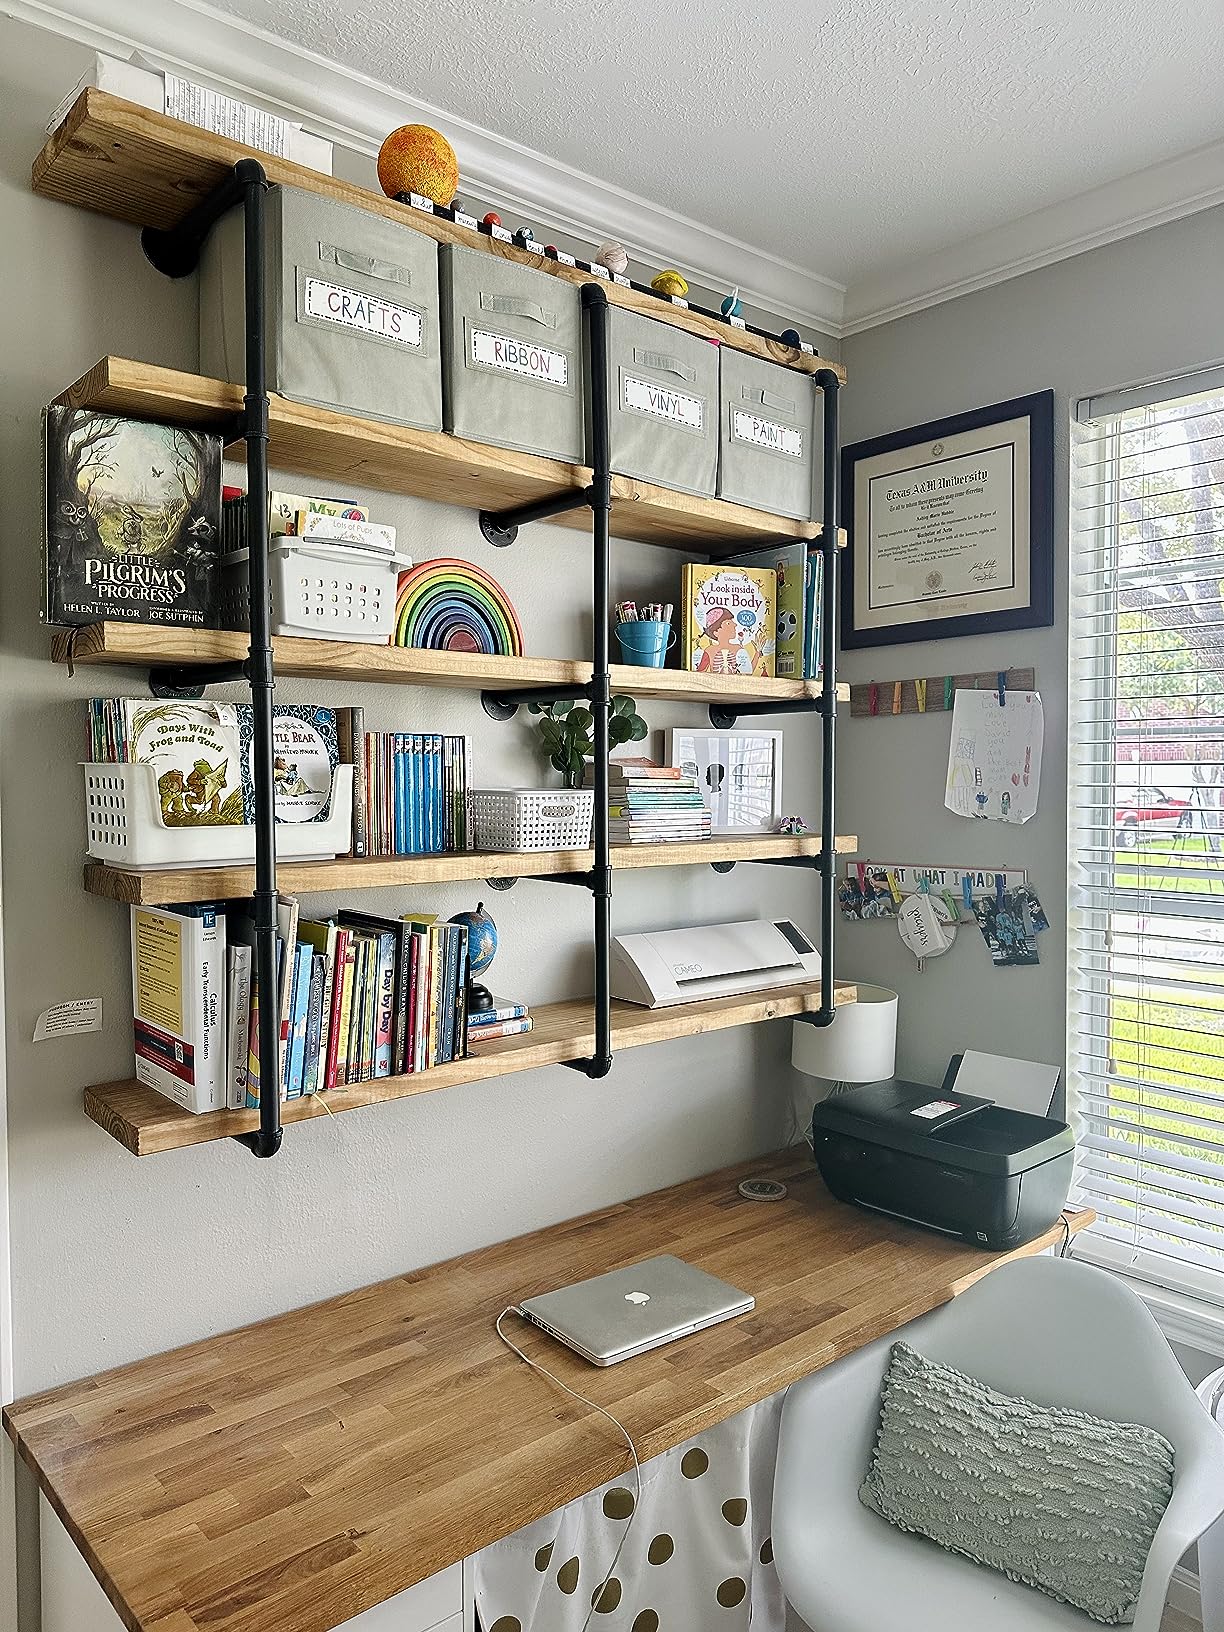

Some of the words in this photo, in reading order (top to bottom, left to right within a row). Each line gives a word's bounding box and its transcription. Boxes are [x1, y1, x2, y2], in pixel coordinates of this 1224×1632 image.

[327, 292, 402, 333] CRAFTS
[494, 341, 551, 374] RIBBON
[648, 390, 685, 417] VINYL
[752, 421, 786, 446] PAINT
[886, 488, 914, 501] Texas
[911, 480, 936, 495] A&M
[938, 469, 988, 489] University
[309, 501, 337, 517] My
[347, 524, 356, 532] of
[356, 524, 373, 535] Pups
[942, 525, 952, 533] Arts
[118, 554, 154, 567] LITTLE
[84, 558, 186, 595] PILGRIM'S
[98, 583, 174, 605] PROGRESS
[710, 582, 730, 593] Look
[731, 584, 755, 595] inside
[63, 603, 93, 614] HELEN
[95, 605, 102, 614] L.
[104, 606, 141, 618] TAYLOR
[701, 591, 730, 607] Your
[731, 594, 763, 612] Body
[148, 610, 164, 621] JOE
[165, 611, 204, 623] SUTPHIN
[322, 712, 326, 720] 1
[156, 723, 187, 735] Days
[188, 723, 216, 737] With
[292, 732, 316, 744] BEAR
[149, 735, 174, 753] Frog
[174, 734, 195, 744] and
[197, 737, 225, 753] Toad
[894, 868, 905, 882] AT
[913, 870, 946, 884] WHAT
[953, 871, 960, 886] I
[966, 872, 1006, 888] MAD!
[907, 906, 928, 946] prayers
[201, 961, 209, 979] Early
[674, 963, 703, 975] CAMEO
[238, 977, 247, 989] The
[382, 969, 394, 992] Day
[209, 992, 218, 1027] Calculus
[381, 993, 392, 1008] by
[380, 1011, 392, 1034] Day
[320, 1020, 328, 1048] STORY
